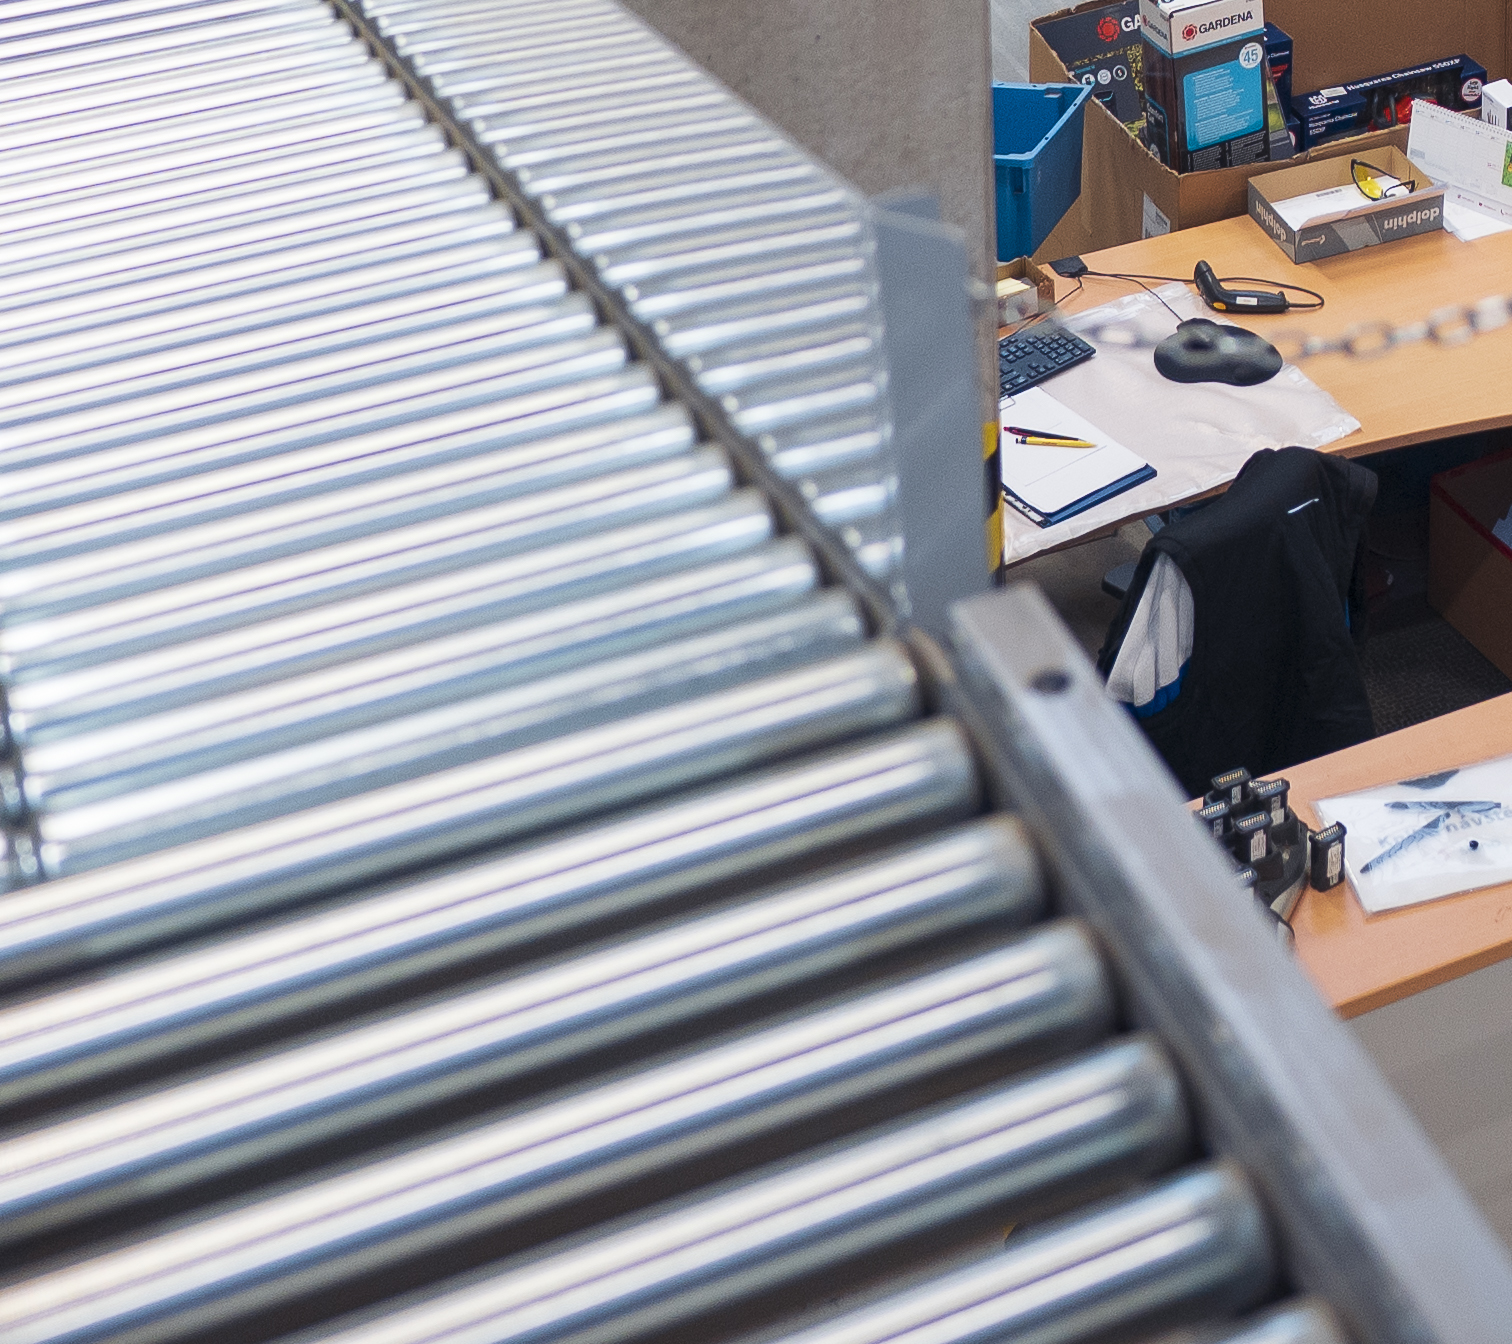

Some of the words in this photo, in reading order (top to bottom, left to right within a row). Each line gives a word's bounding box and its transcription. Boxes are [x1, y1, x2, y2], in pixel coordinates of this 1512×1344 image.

[1199, 11, 1254, 34] GARDENA
[1242, 48, 1260, 65] 45
[1391, 65, 1433, 80] Chainsaw
[1255, 200, 1288, 242] dolphin
[1383, 207, 1441, 231] dolphin
